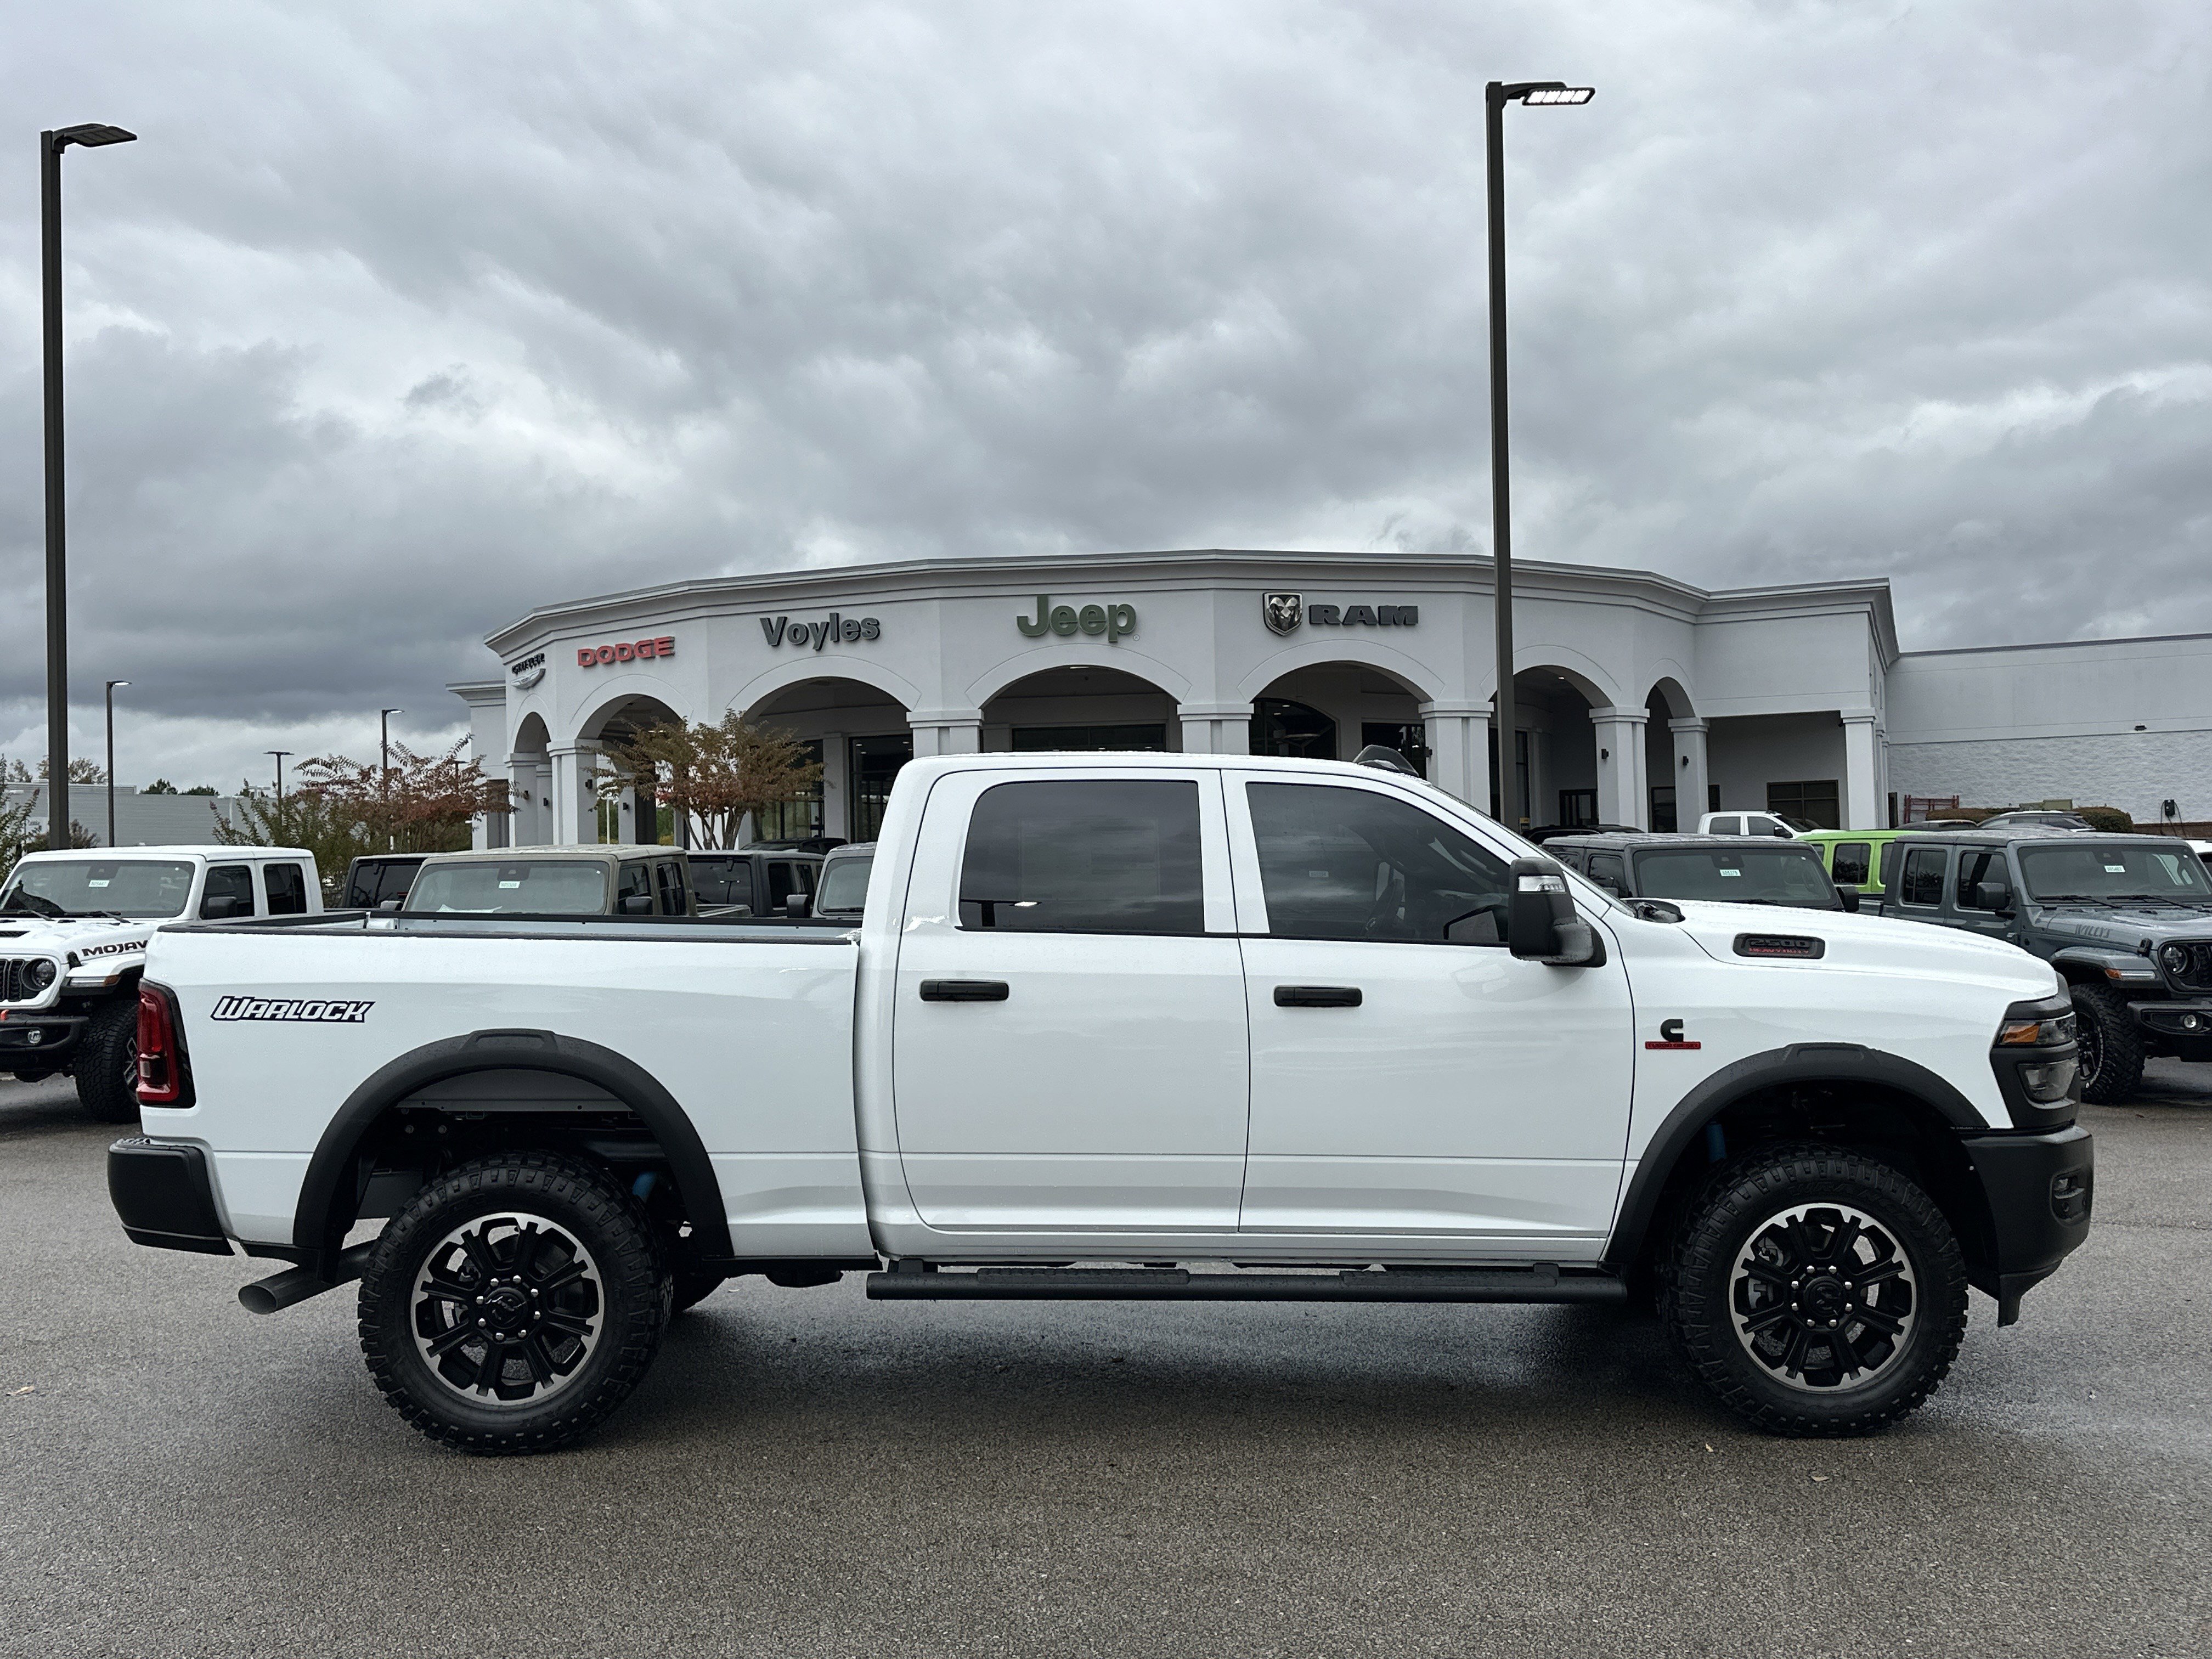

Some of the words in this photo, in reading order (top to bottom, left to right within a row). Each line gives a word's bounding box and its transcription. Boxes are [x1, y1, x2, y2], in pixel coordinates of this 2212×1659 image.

[1017, 595, 1136, 642] Jeep
[1308, 604, 1418, 625] RAM
[760, 612, 880, 651] Voyles
[578, 636, 675, 667] DODGE
[81, 940, 148, 956] MOJAV
[1748, 938, 1810, 948] 2500
[210, 996, 376, 1023] WARLOCK
